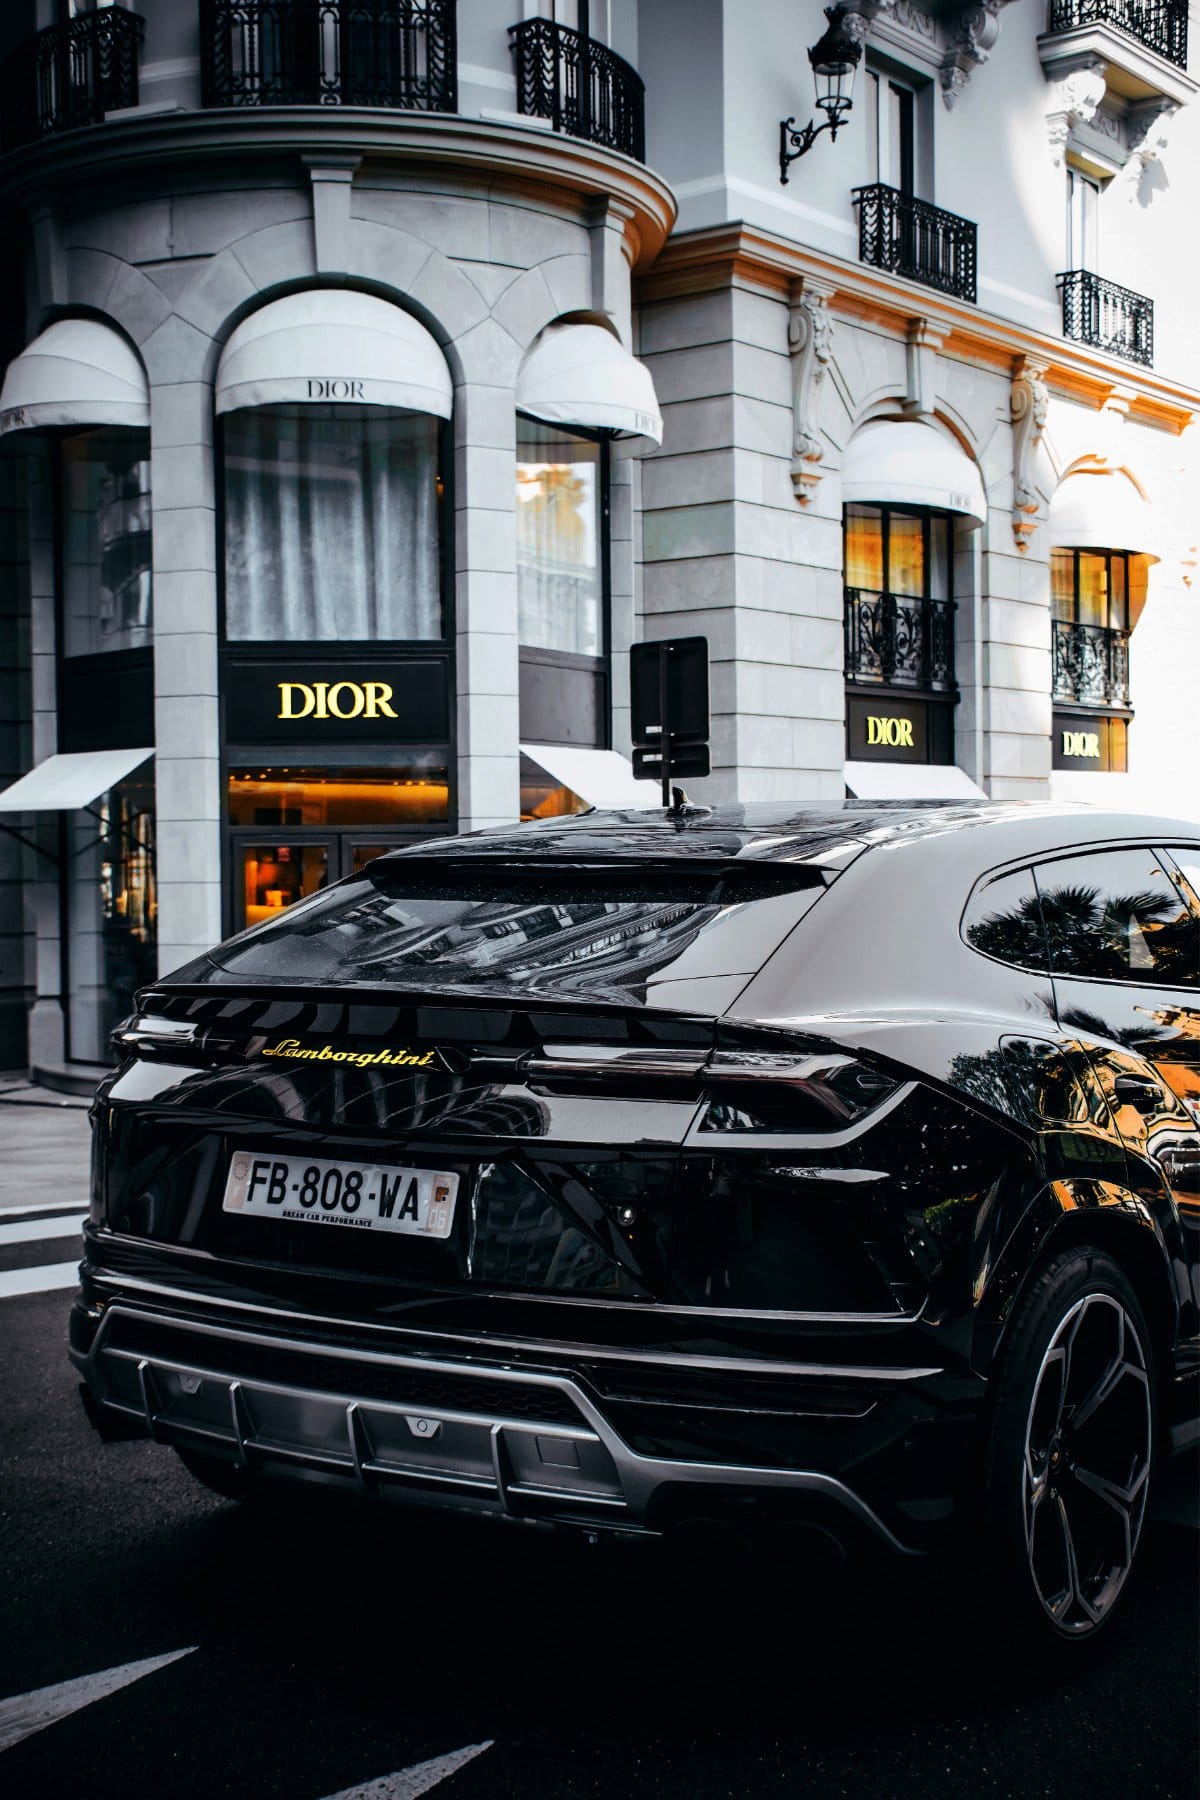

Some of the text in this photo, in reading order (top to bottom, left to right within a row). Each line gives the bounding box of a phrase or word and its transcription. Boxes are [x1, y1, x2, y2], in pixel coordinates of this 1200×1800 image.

[307, 380, 366, 399] DIOR
[277, 681, 399, 719] DIOR
[866, 716, 914, 746] DIOR
[1062, 731, 1101, 758] DIOR
[262, 1039, 435, 1067] Lamborghini
[282, 1210, 373, 1228] DREAM CAR PERFORMANCE
